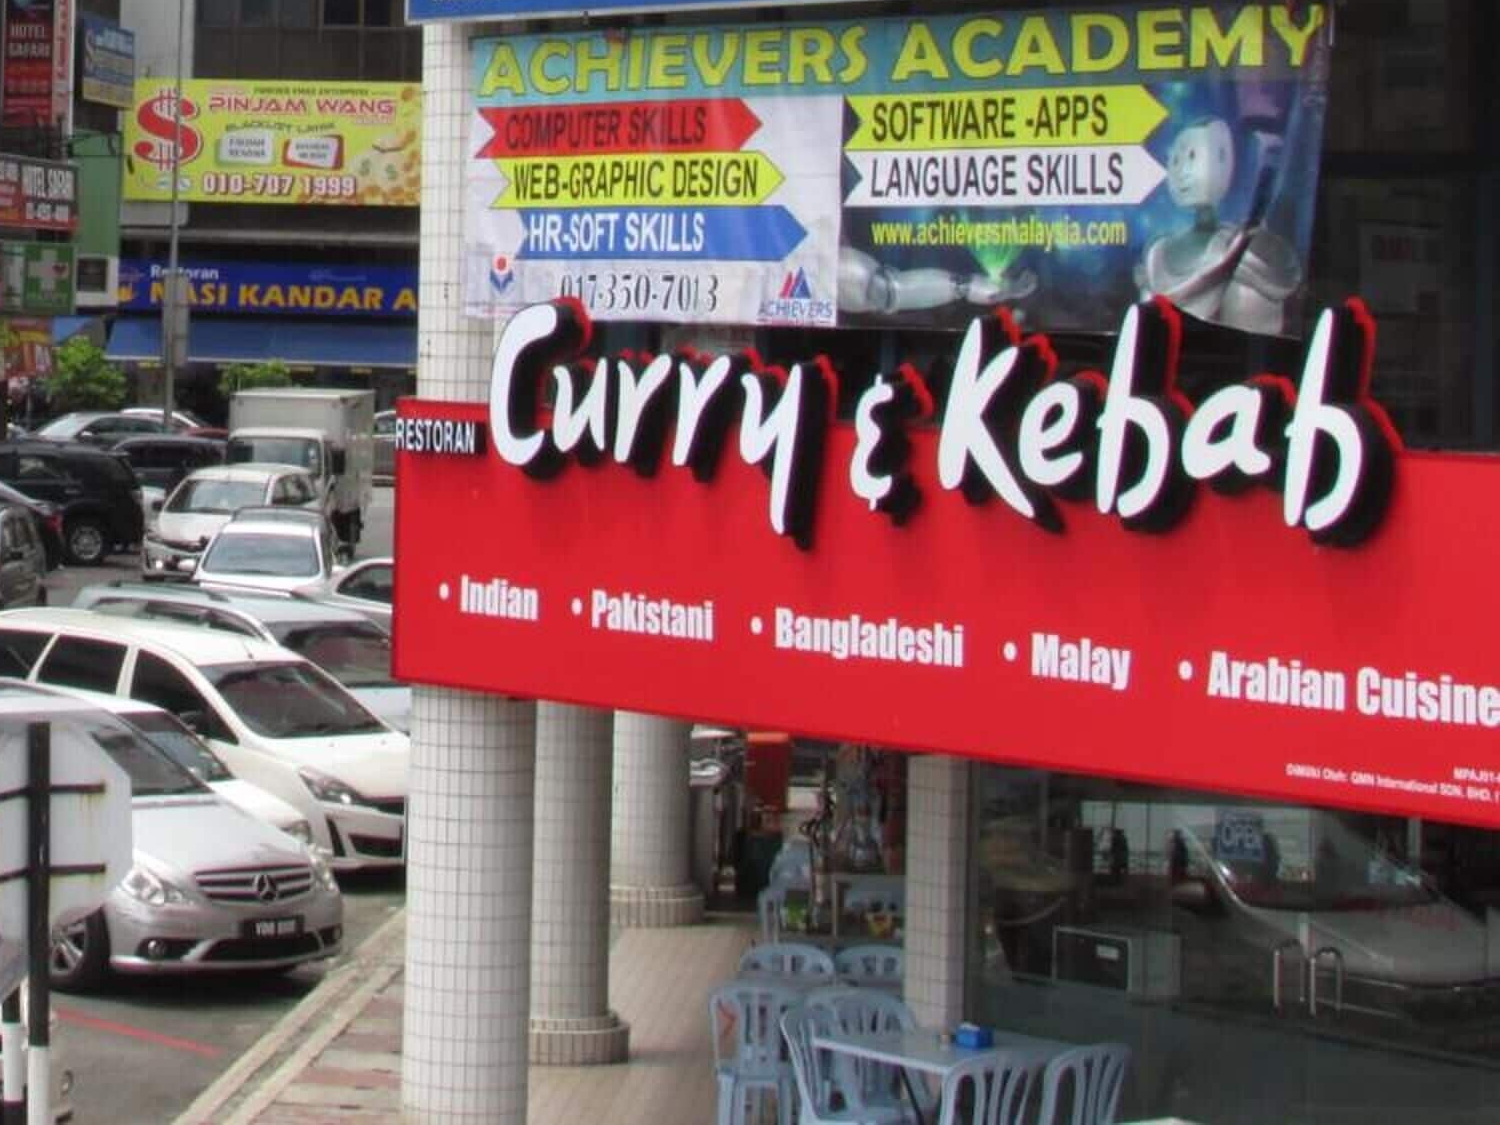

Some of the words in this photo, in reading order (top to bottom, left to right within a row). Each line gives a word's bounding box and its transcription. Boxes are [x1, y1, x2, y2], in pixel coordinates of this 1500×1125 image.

[477, 24, 870, 98] ACHIEVERS
[891, 2, 1326, 81] ACADEMY
[208, 95, 308, 115] PINJAM
[316, 98, 395, 116] WANG
[870, 94, 1017, 142] SOFTWARE
[504, 111, 623, 151] COMPUTER
[627, 105, 708, 146] SKILLS
[513, 159, 668, 201] WEB-GRAPHIC
[671, 157, 759, 197] DESIGN
[869, 154, 1019, 199] LANGUAGE
[1026, 151, 1124, 196] SKILLS
[527, 212, 620, 253] HR-SOFT
[623, 212, 707, 254] SKILLS
[871, 216, 1128, 251] www.achieversmalaysia.com
[238, 284, 383, 310] KANDAR
[757, 299, 833, 318] ACHIEVERS
[396, 418, 475, 456] RESTORAN
[489, 302, 803, 537] Curry
[848, 373, 895, 513] &
[937, 302, 1365, 533] Kebab
[459, 574, 539, 623] Indian
[591, 588, 714, 642] Pakistani
[774, 606, 965, 667] Bangladeshi
[1031, 632, 1132, 691] Malay
[1207, 649, 1346, 713] Arabian
[1356, 664, 1500, 727] Cuisine
